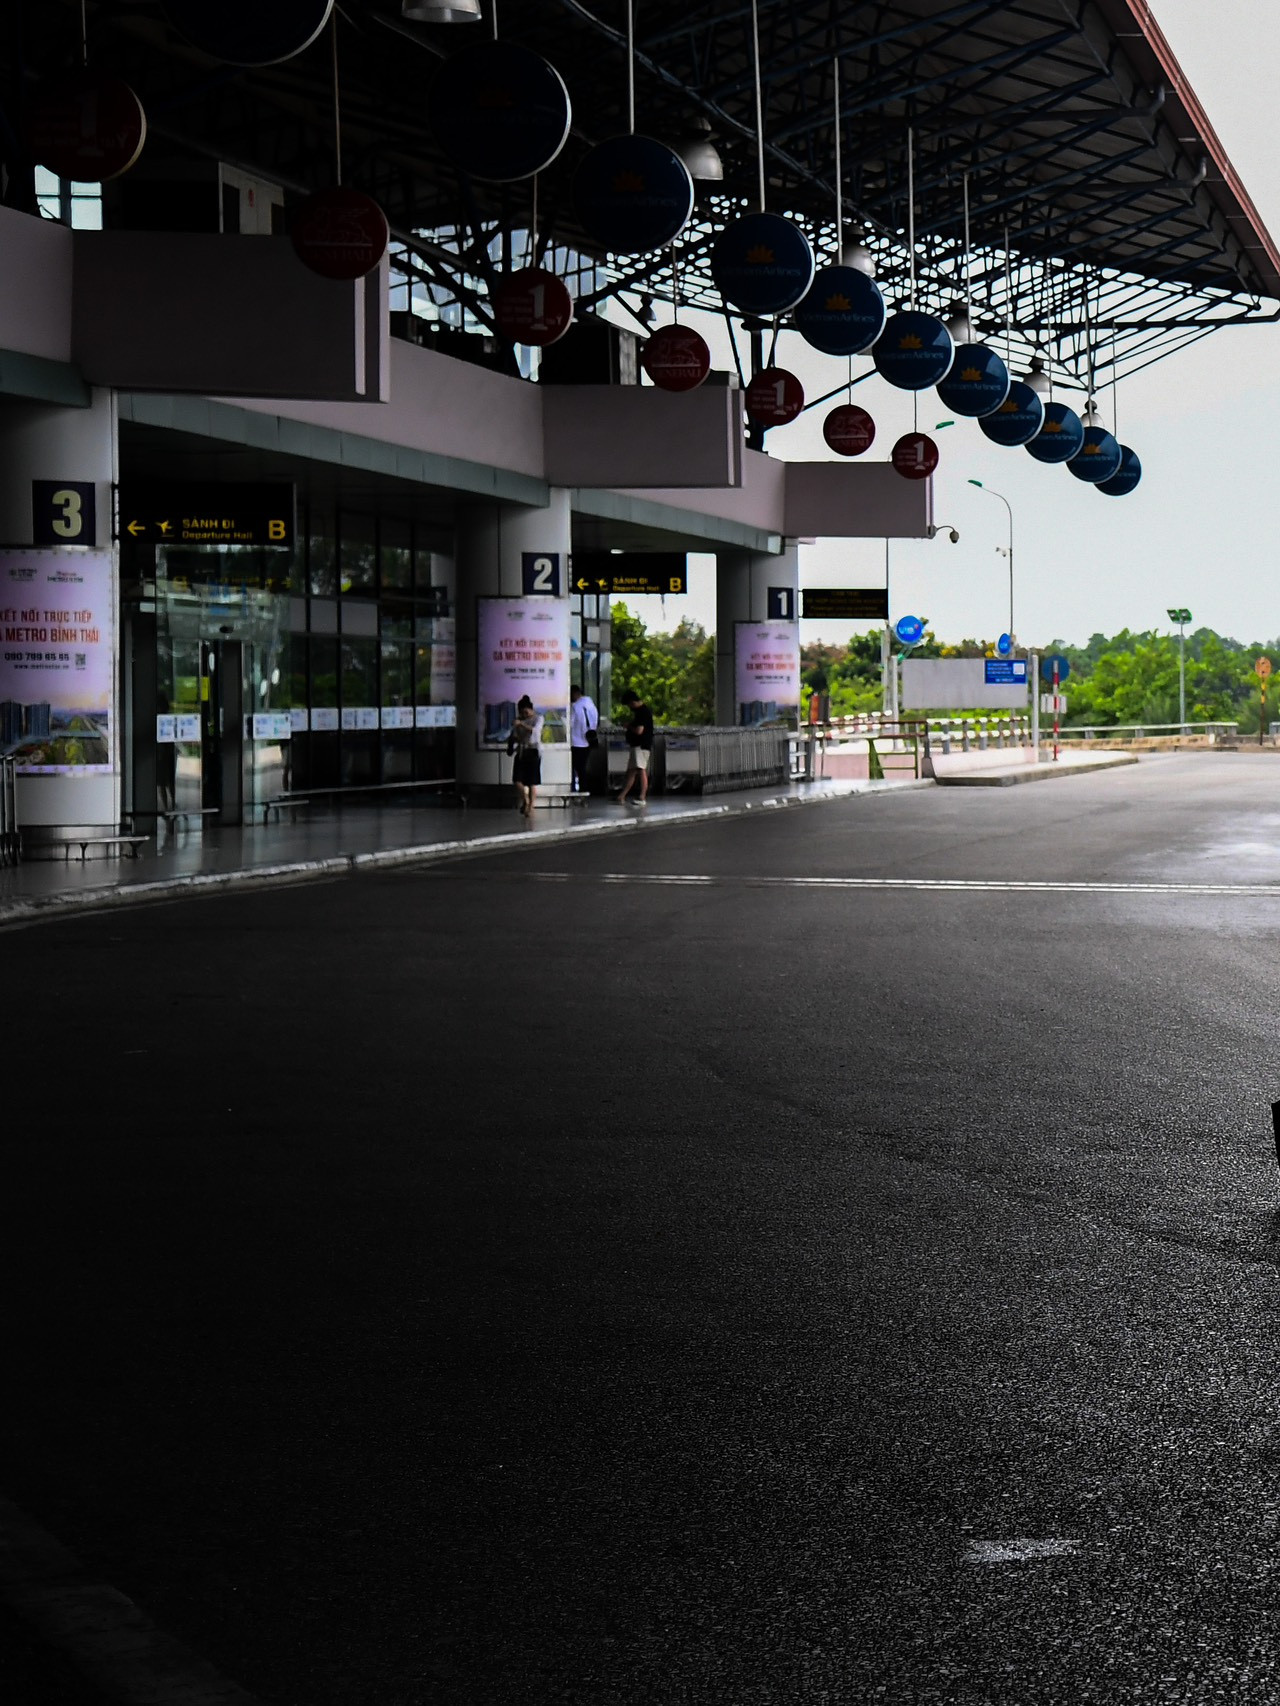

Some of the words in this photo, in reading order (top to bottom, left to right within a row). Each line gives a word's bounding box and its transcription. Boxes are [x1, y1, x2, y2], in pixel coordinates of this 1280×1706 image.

[51, 489, 83, 538] 3
[182, 530, 231, 540] Departure
[234, 530, 253, 540] Hall
[268, 519, 286, 540] B
[533, 557, 553, 591] 2
[669, 577, 682, 592] B
[777, 590, 788, 616] 1
[5, 628, 47, 642] METRO
[50, 625, 77, 642] BÌNH
